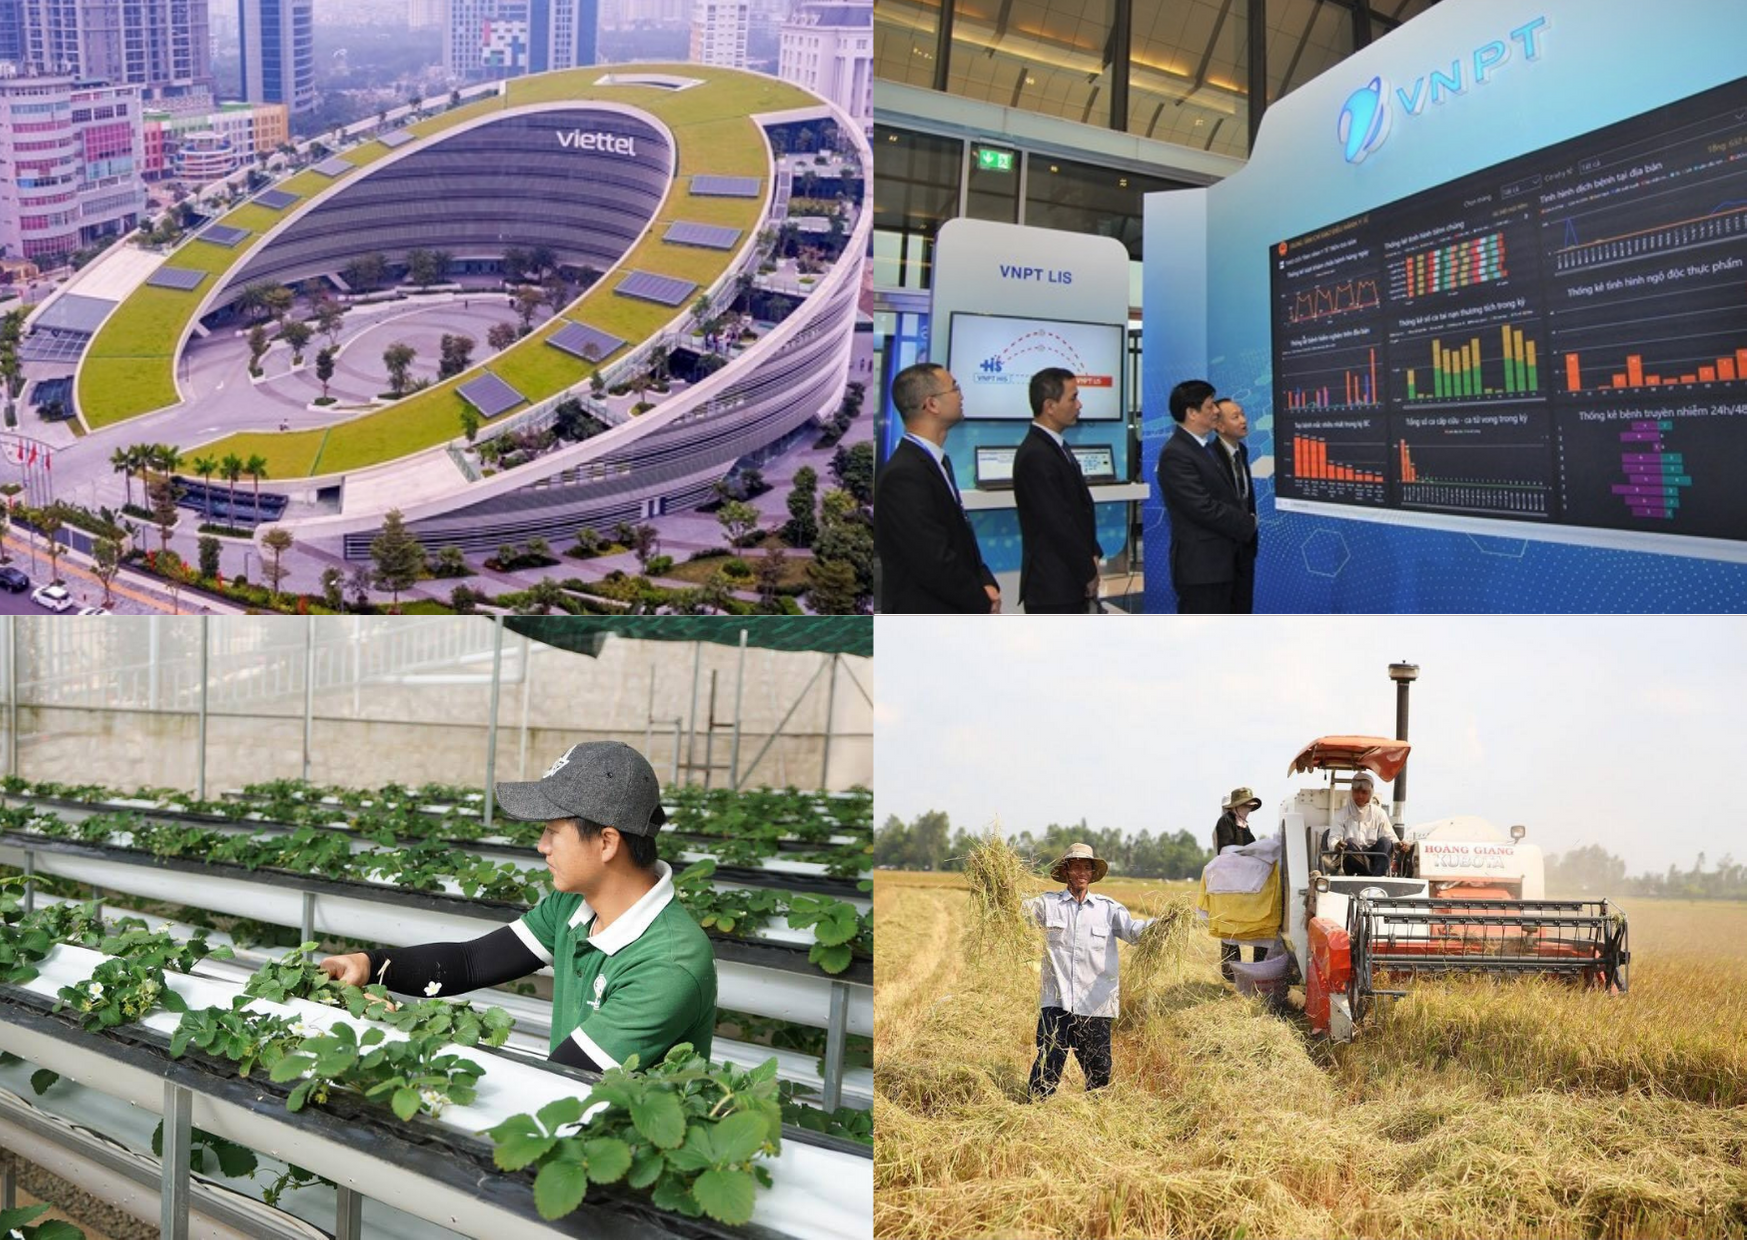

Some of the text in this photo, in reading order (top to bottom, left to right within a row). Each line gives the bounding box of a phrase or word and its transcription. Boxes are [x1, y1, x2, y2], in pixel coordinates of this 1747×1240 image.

[1396, 16, 1547, 115] VNPT
[556, 129, 636, 156] viettel
[1000, 265, 1072, 284] VNPT LIS
[1473, 846, 1514, 855] GIANG
